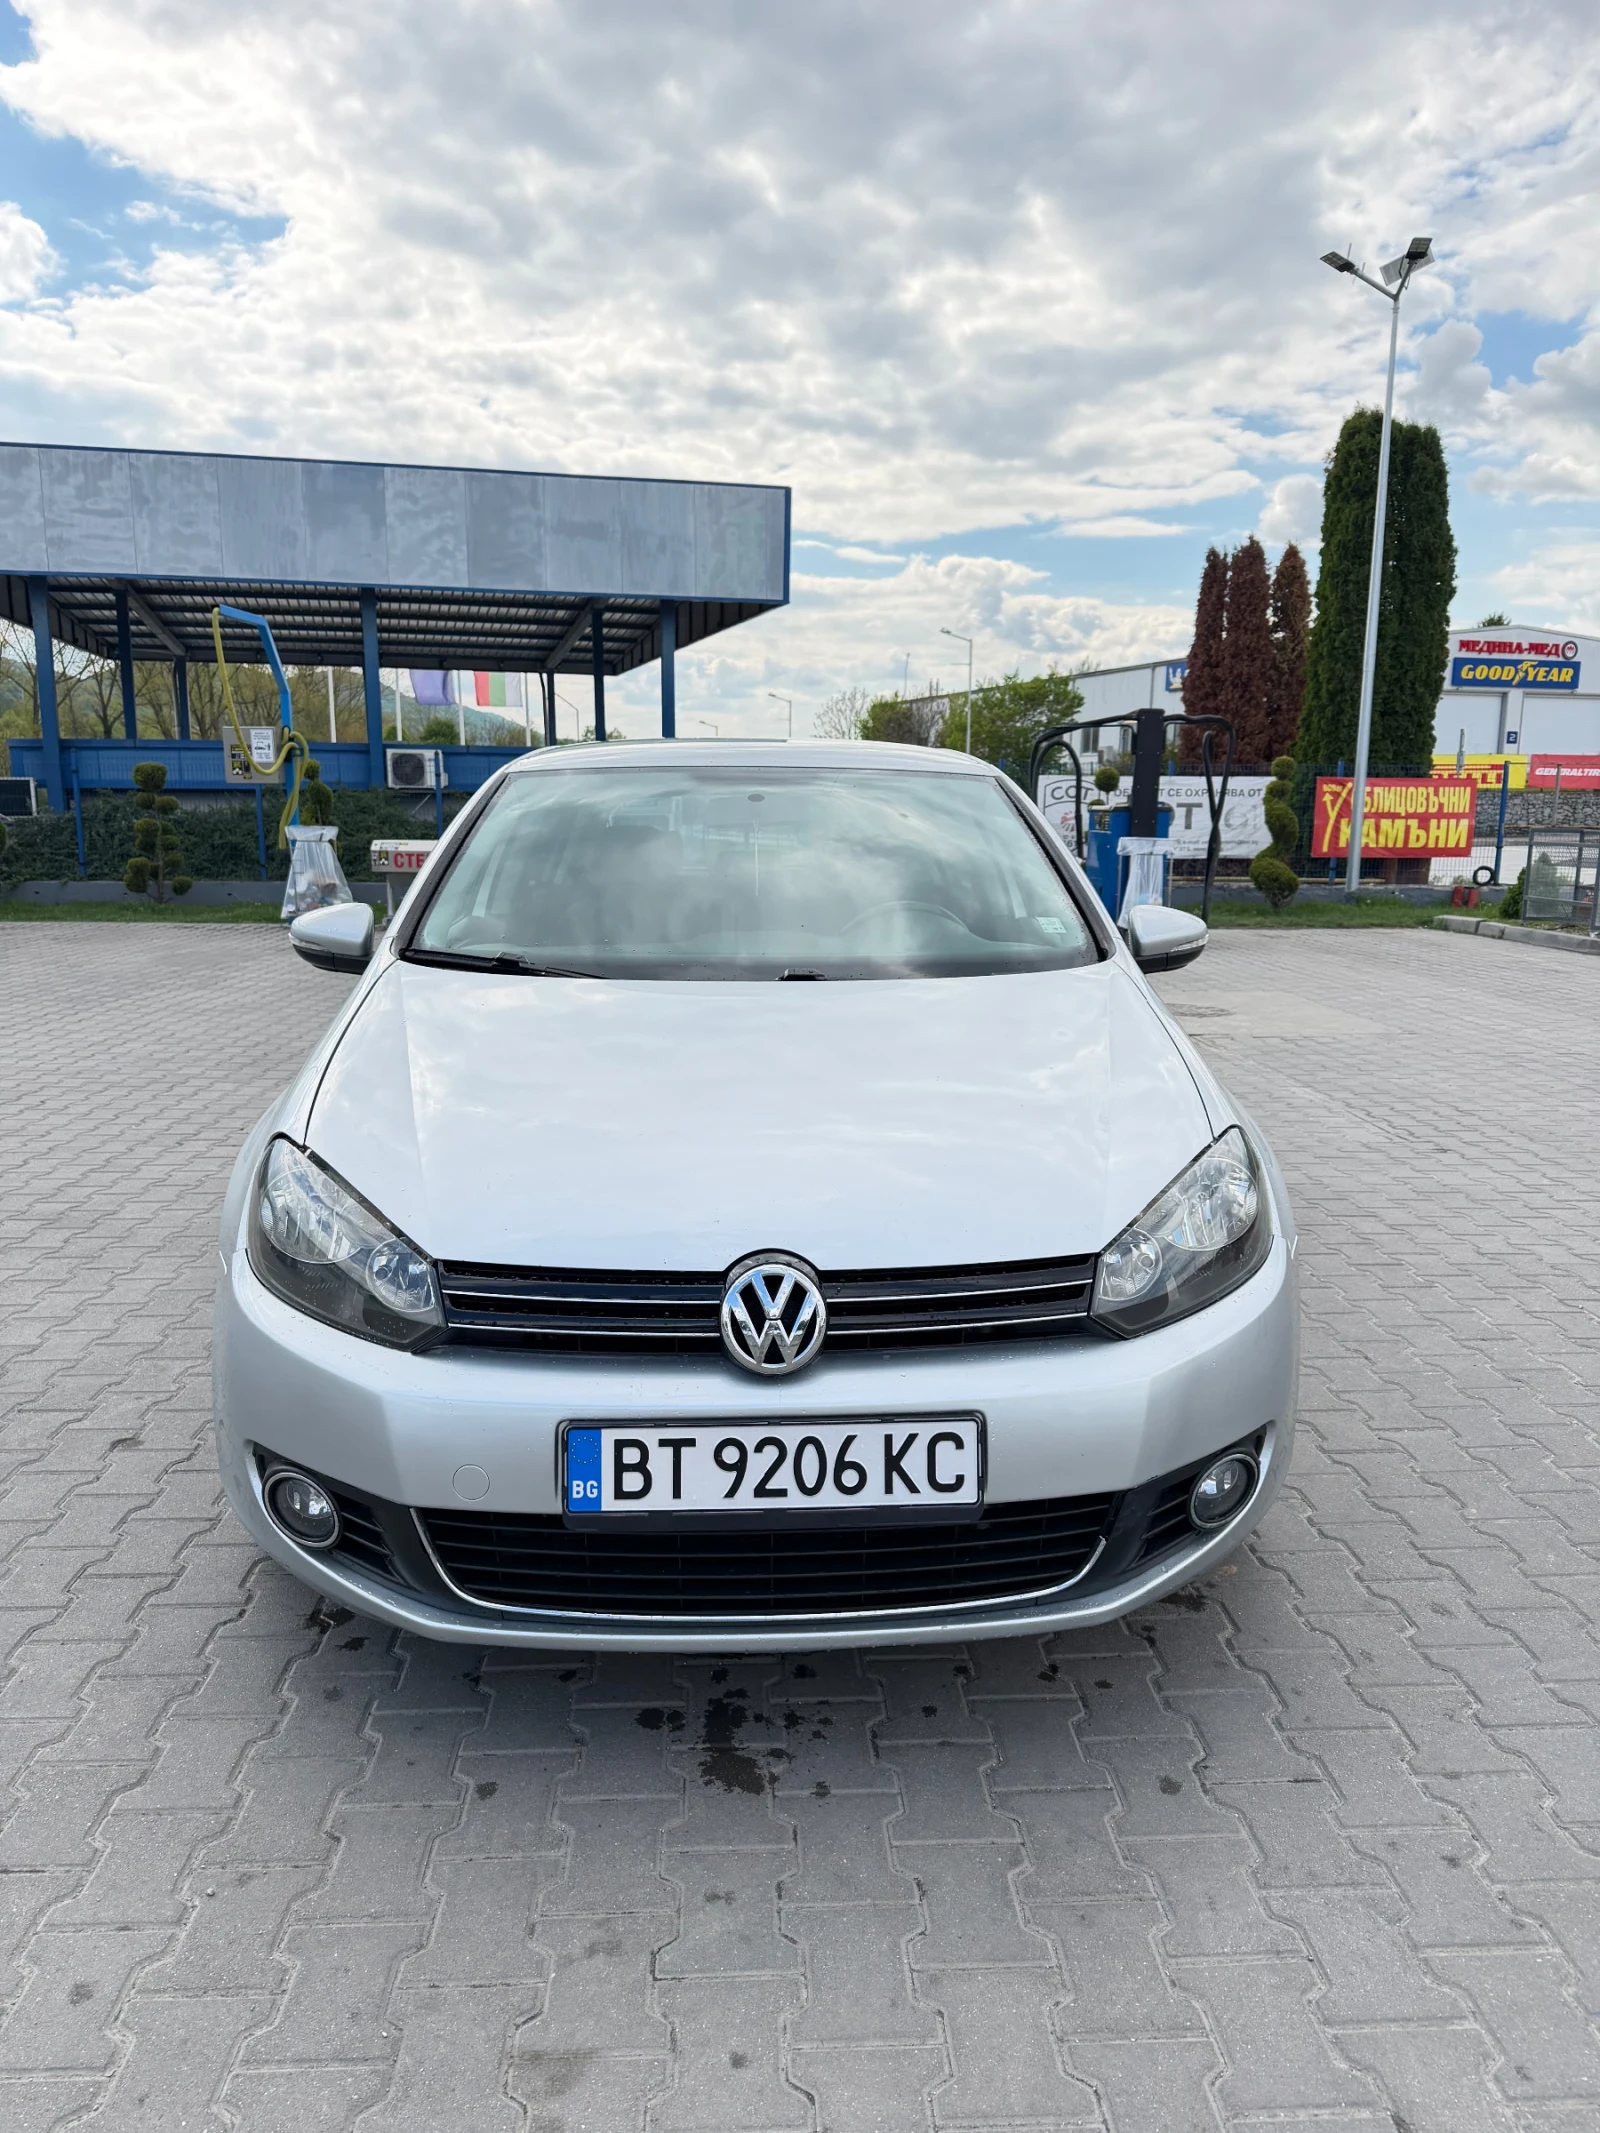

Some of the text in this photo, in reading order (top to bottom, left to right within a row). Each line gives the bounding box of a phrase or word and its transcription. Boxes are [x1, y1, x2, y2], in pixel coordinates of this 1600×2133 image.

[1185, 788, 1245, 798] ОХРНЯВА
[1247, 788, 1263, 798] ОТ
[1350, 786, 1472, 816] БЛИЦОВЪЧНИ
[613, 1432, 965, 1500] BT 9206 KC
[572, 1480, 598, 1499] BG
